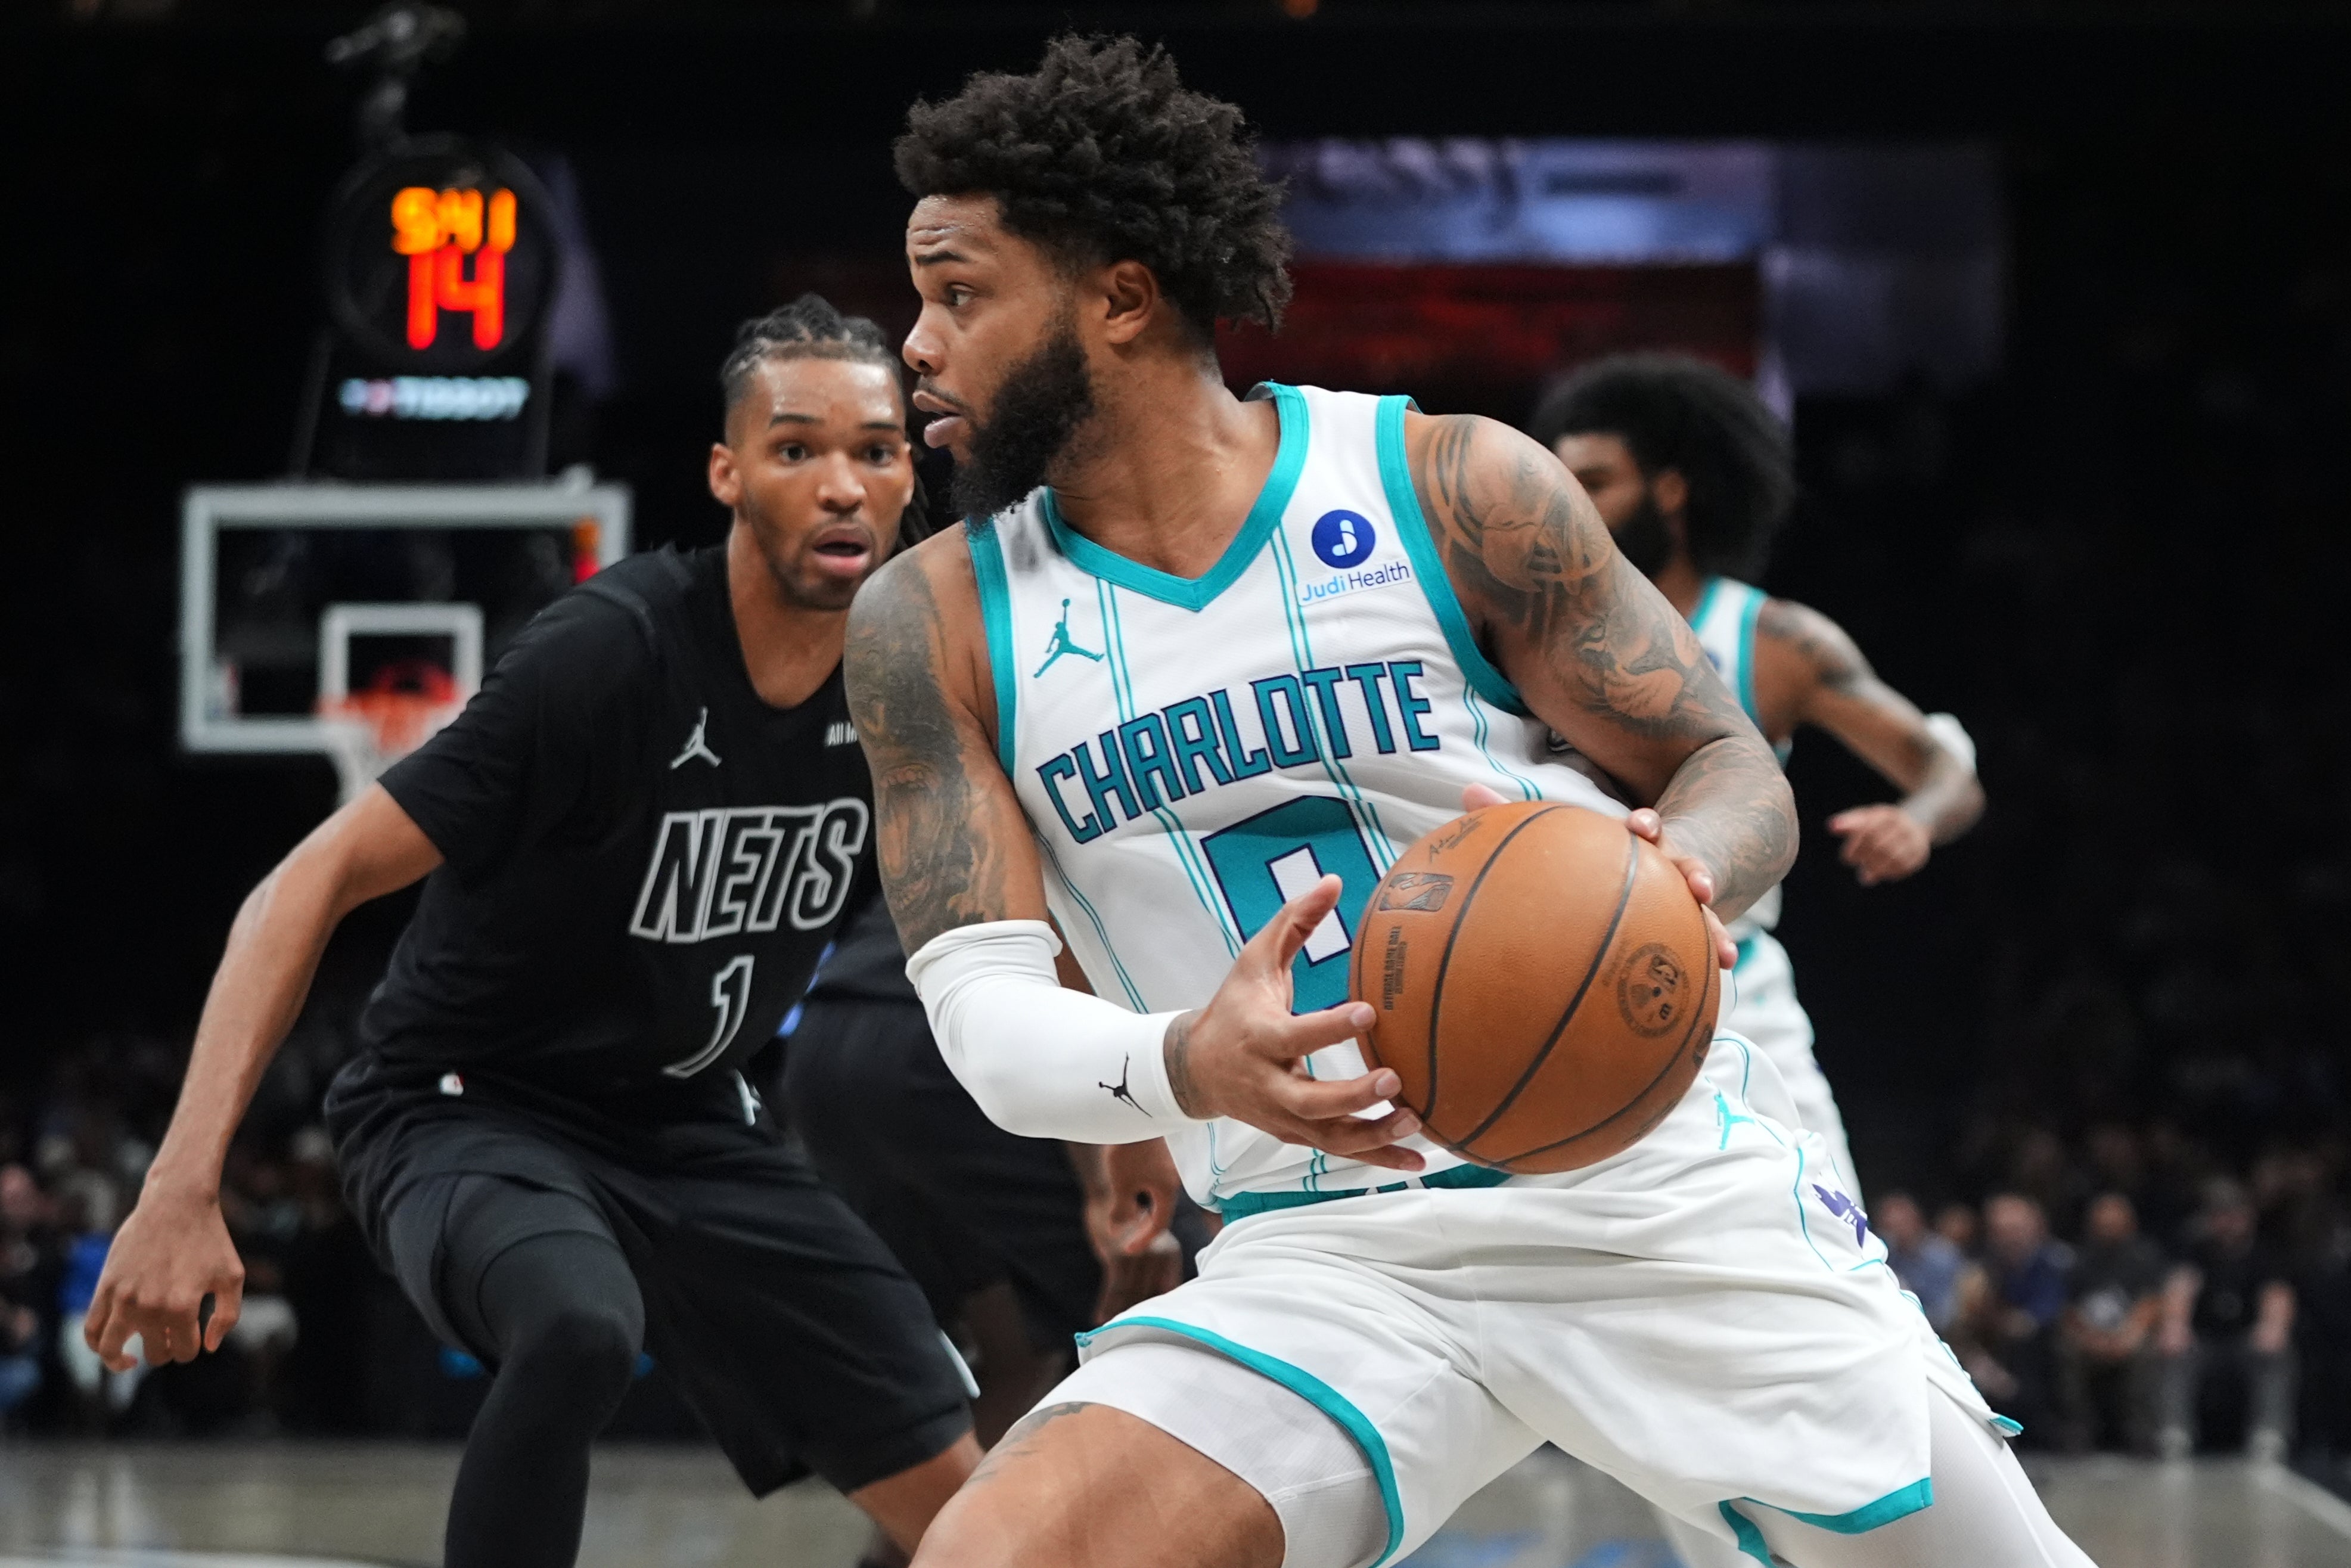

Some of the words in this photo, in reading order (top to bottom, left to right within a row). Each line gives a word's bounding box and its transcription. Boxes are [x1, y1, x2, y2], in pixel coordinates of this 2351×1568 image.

[408, 246, 505, 350] 14
[1302, 576, 1346, 601] Judi
[1348, 561, 1410, 590] Health
[1036, 660, 1440, 845] CHARLOTTE
[630, 797, 869, 943] NETS
[1200, 795, 1381, 1016] 0
[661, 955, 754, 1077] 1
